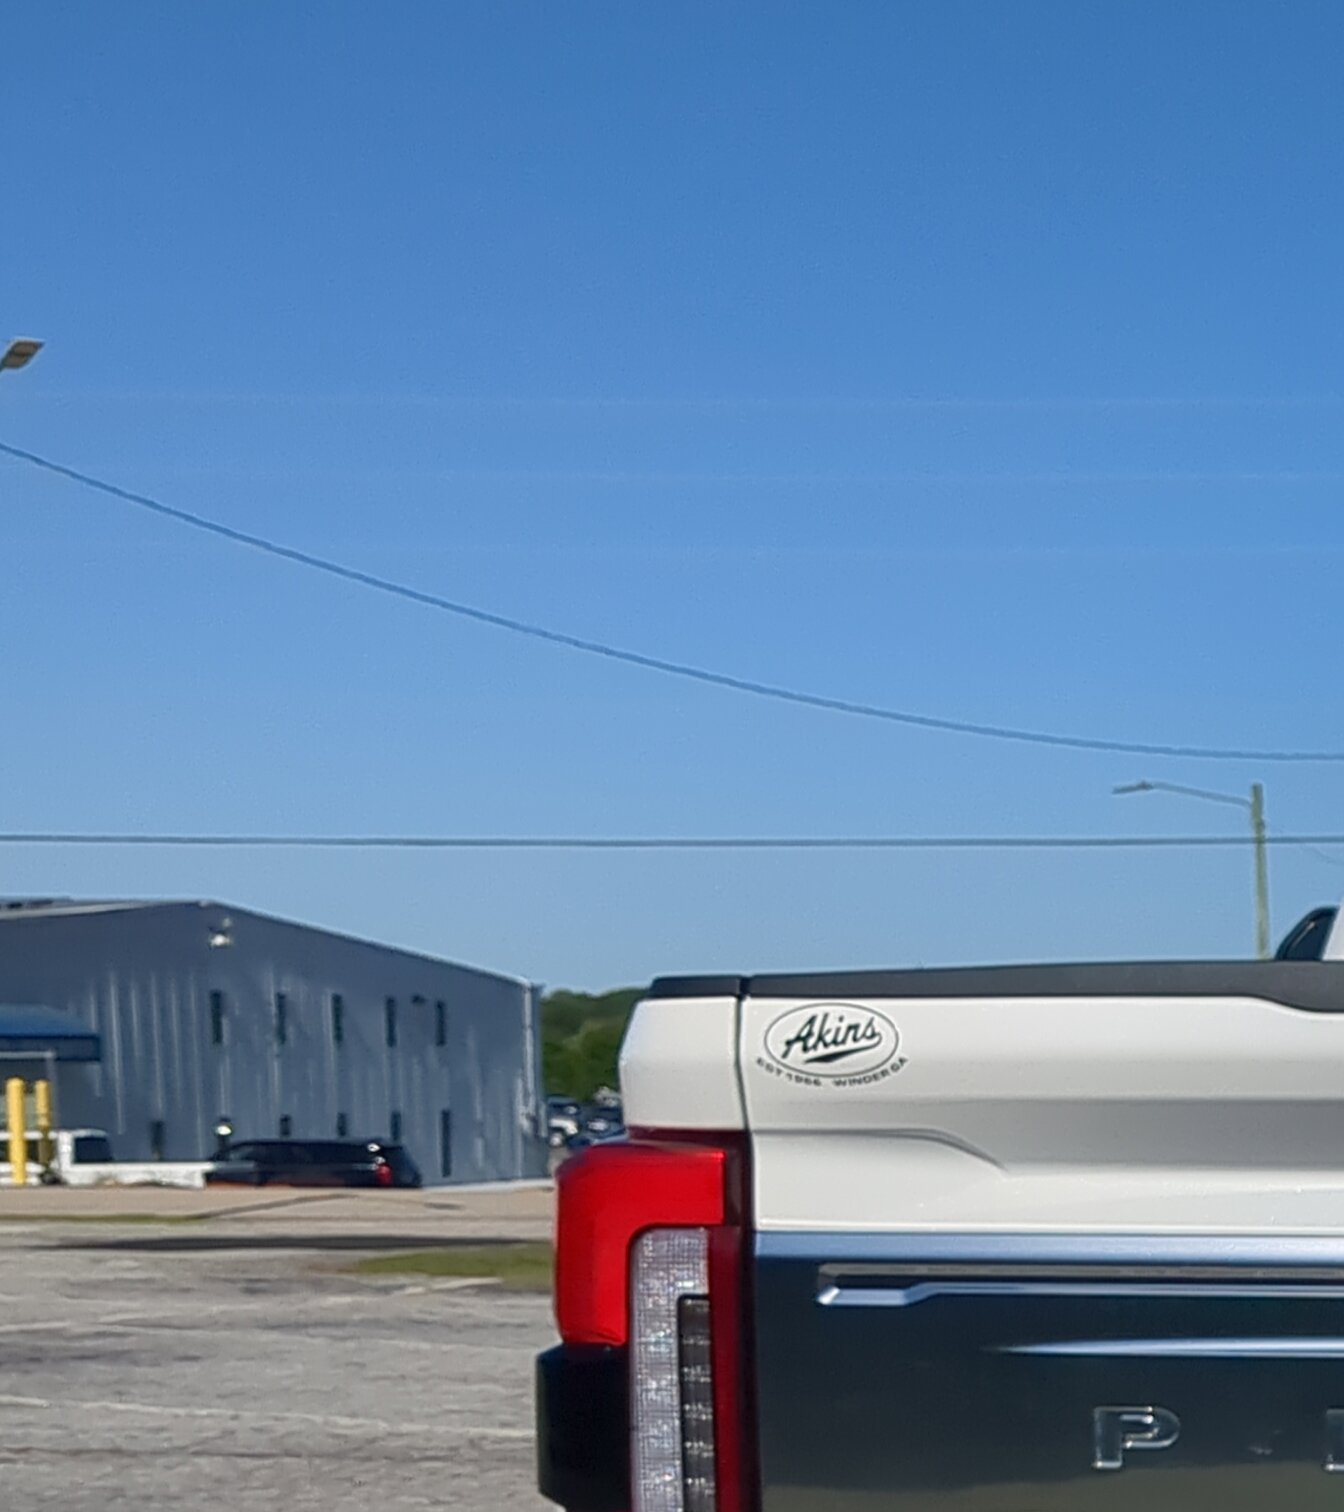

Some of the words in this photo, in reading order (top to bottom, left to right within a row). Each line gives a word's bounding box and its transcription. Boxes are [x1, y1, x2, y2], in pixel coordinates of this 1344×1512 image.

[781, 1012, 883, 1061] Akins
[832, 1068, 891, 1087] WINDER
[890, 1056, 909, 1073] GA
